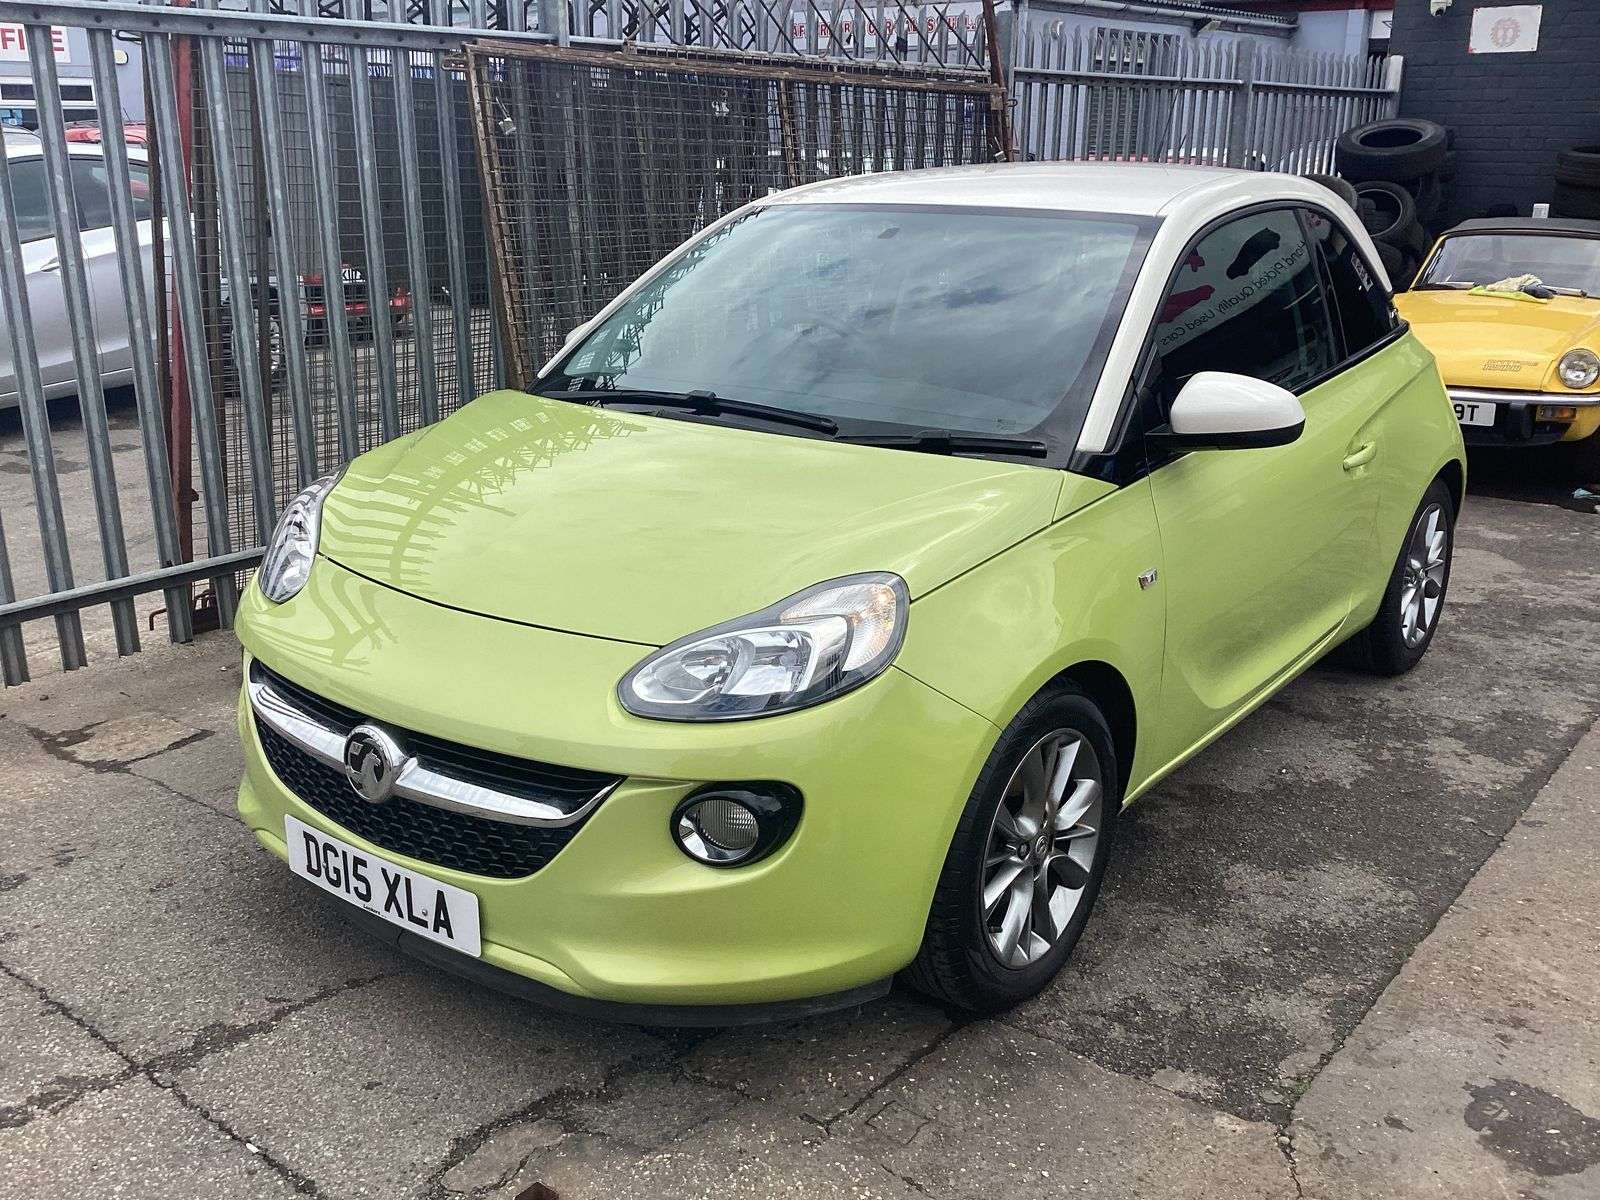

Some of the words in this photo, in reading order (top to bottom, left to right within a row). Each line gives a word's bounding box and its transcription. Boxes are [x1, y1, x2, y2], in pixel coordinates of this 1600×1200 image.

[0, 28, 65, 51] FIE
[302, 830, 372, 903] DG15
[381, 867, 455, 940] XLA
